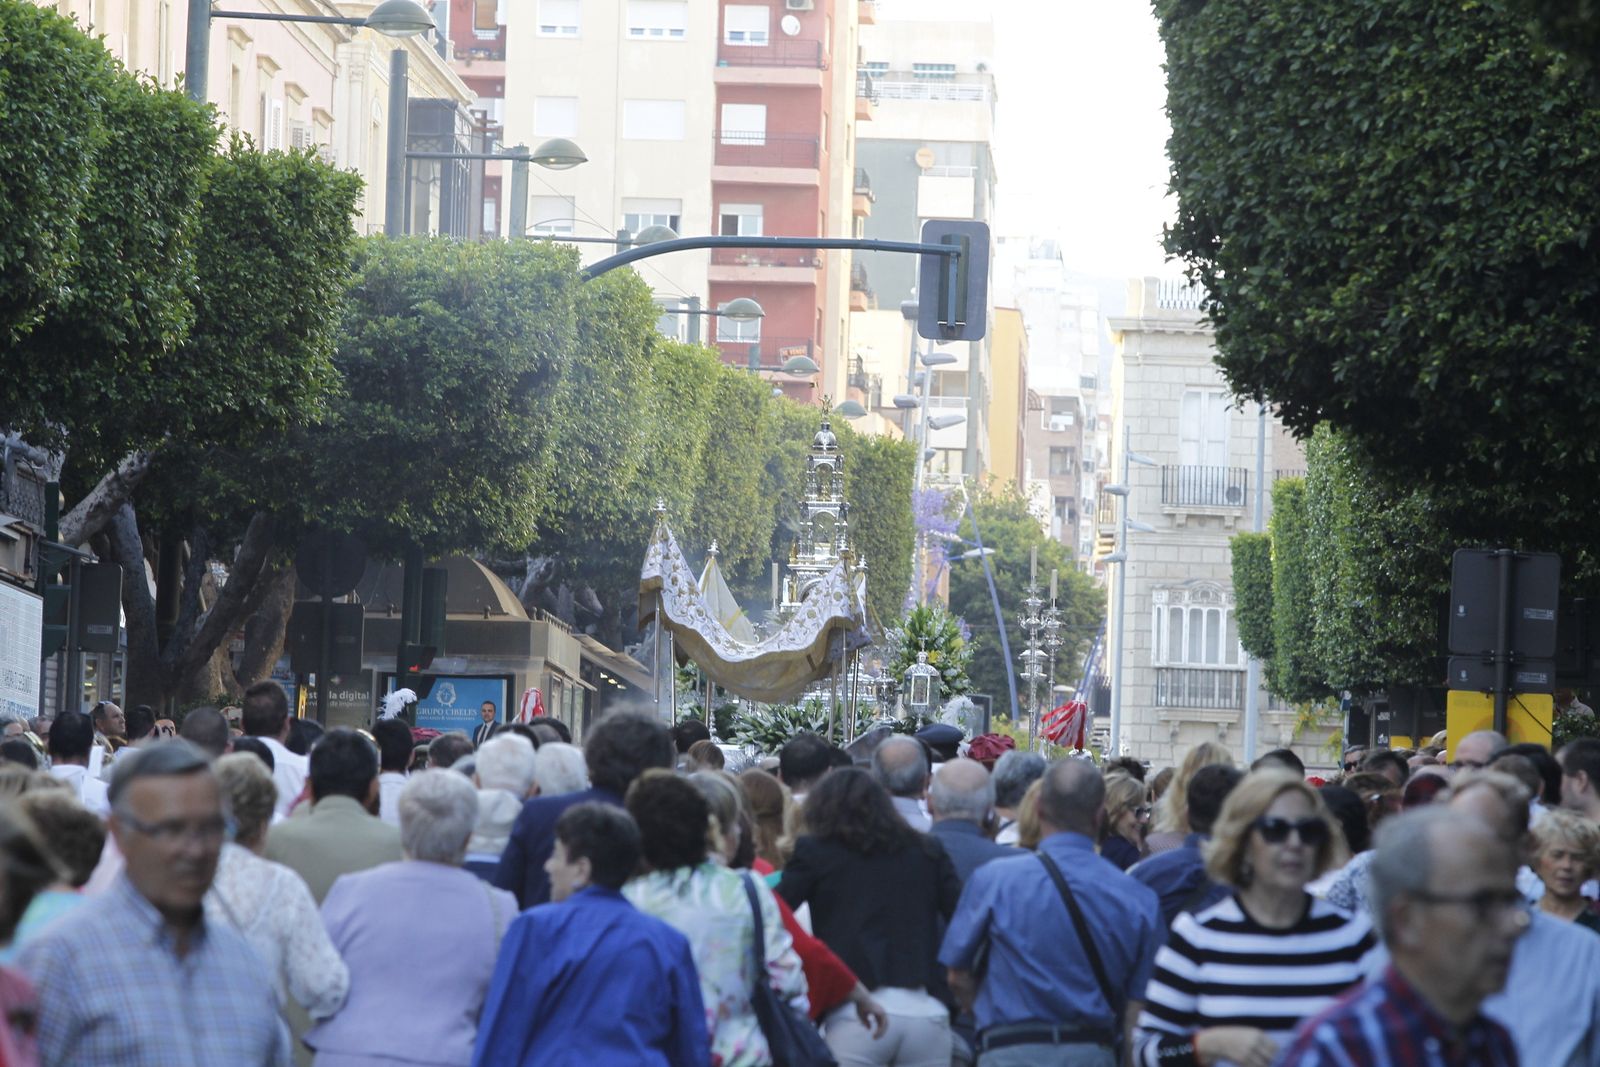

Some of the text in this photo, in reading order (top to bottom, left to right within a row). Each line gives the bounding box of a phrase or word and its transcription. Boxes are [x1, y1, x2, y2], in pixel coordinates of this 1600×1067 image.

[339, 690, 370, 702] digital
[416, 708, 477, 716] GRUPO CIBELES
